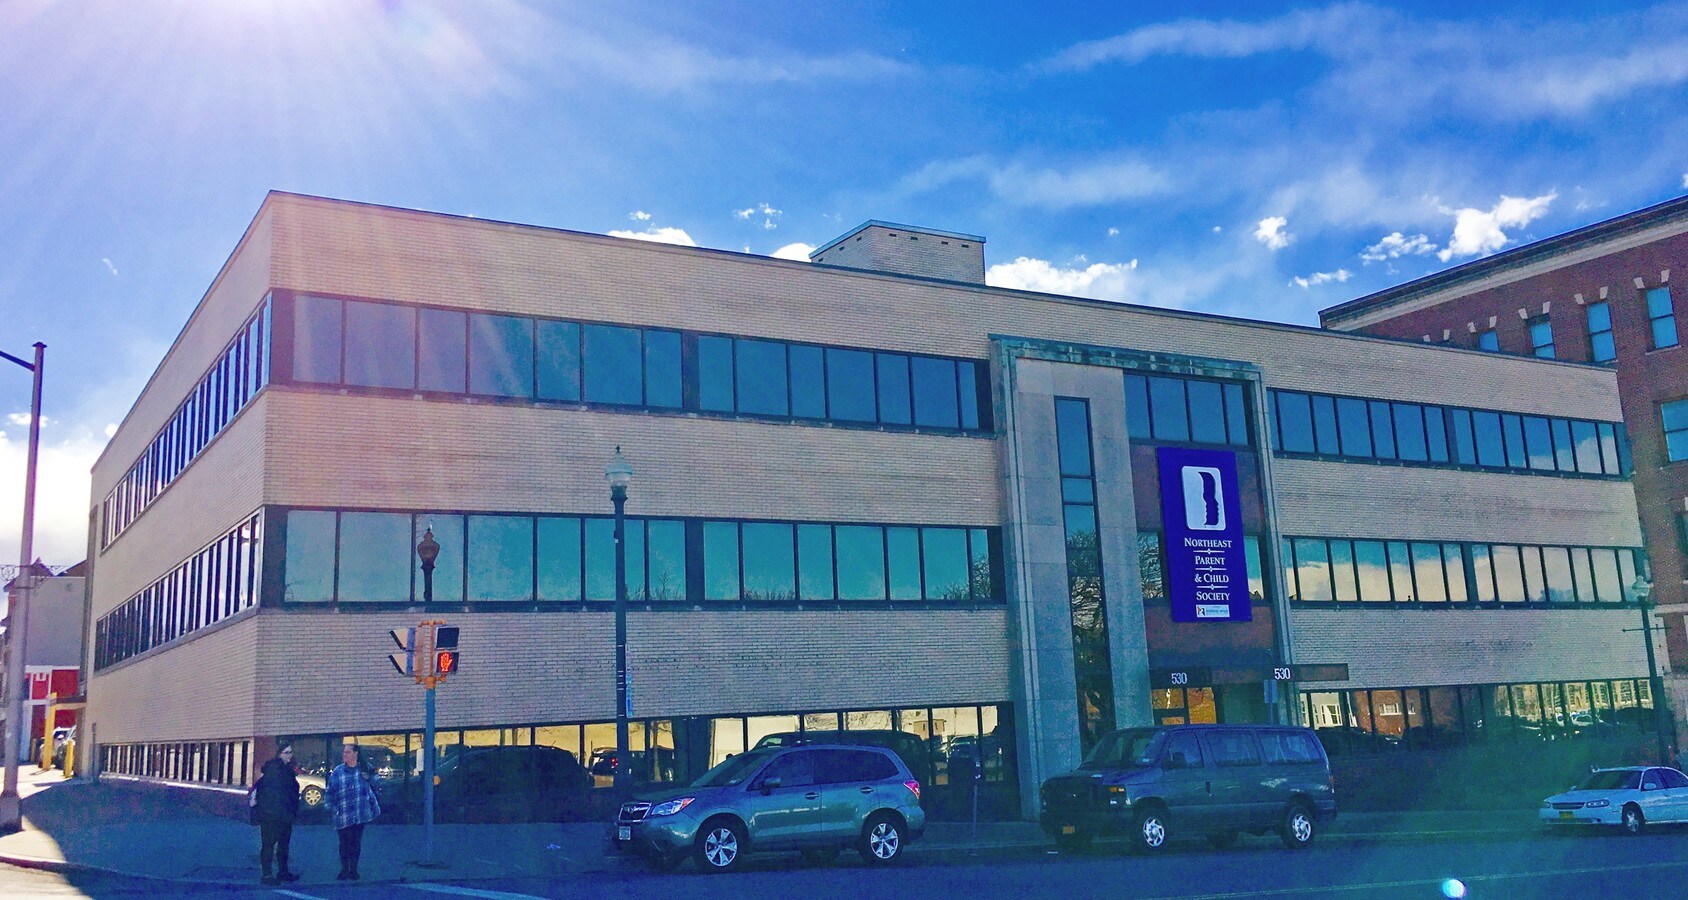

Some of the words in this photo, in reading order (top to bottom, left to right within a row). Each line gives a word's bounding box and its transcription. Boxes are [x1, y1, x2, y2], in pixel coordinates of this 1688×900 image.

[1184, 537, 1232, 548] NORTHEAST
[1195, 555, 1225, 565] PARENT
[1194, 573, 1202, 583] &
[1203, 573, 1229, 583] CHILD
[1196, 591, 1230, 601] SOCIETY
[1171, 672, 1188, 685] 530
[1274, 667, 1291, 680] 530
